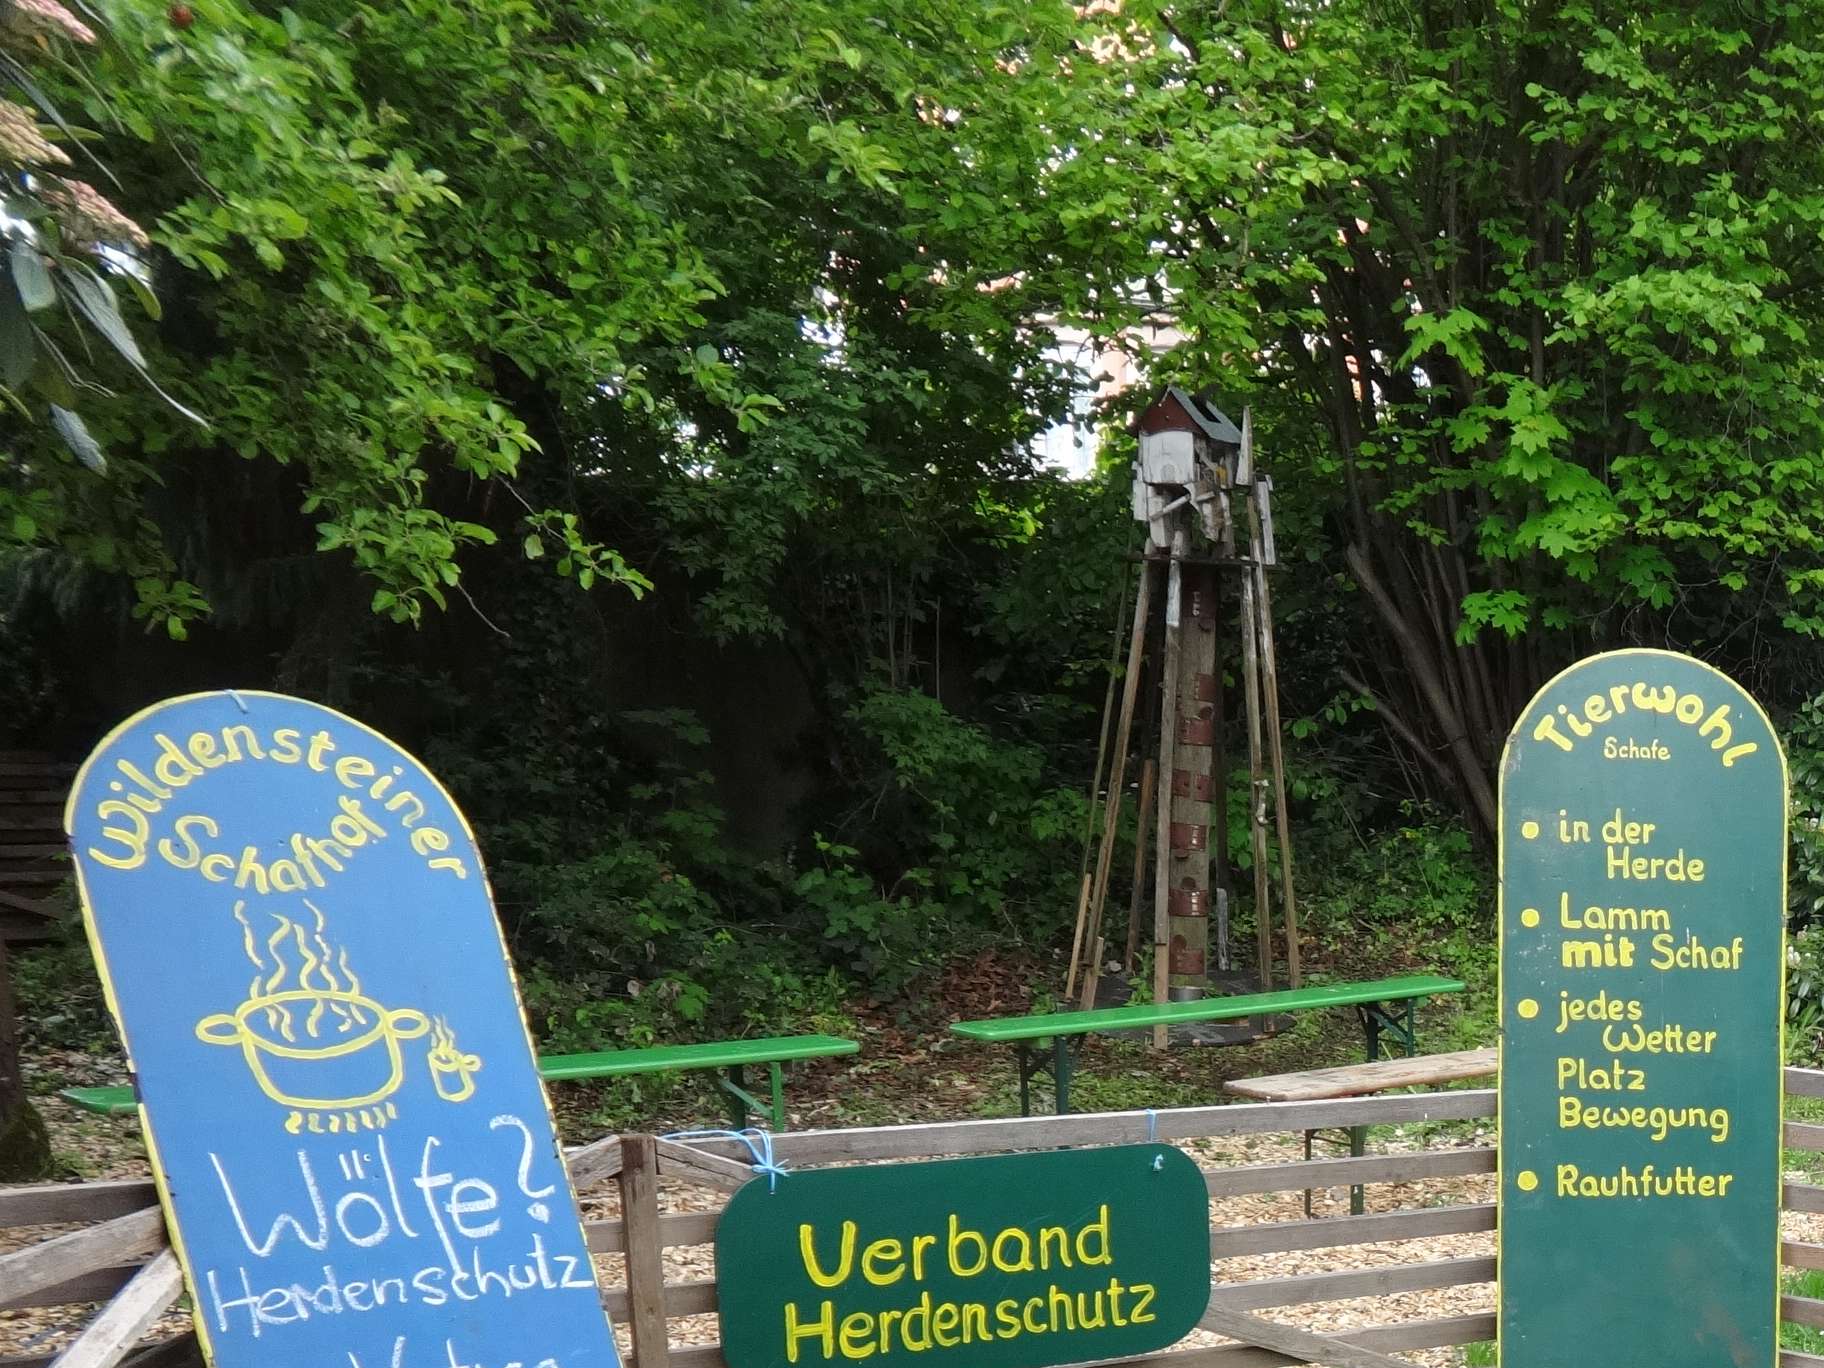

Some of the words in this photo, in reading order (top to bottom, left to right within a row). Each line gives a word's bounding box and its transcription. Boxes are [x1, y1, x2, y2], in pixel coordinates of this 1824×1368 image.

[1533, 682, 1757, 767] Tierwohl
[1603, 737, 1671, 760] Schafe
[89, 724, 467, 879] Wildensteiner
[158, 796, 387, 893] Schafhof
[1559, 809, 1591, 842] in
[1602, 808, 1656, 844] der
[1607, 846, 1705, 881] Herde
[1560, 892, 1671, 930] Lamm
[1562, 934, 1635, 968] mit
[1650, 934, 1743, 970] Schaf
[1556, 990, 1642, 1033] jedes
[1603, 1024, 1717, 1053] Wetter
[1558, 1057, 1645, 1090] Platz
[1559, 1096, 1729, 1142] Bewegung
[208, 1114, 556, 1275] Wölfe?
[1557, 1165, 1733, 1197] Rauhfutter
[799, 1204, 1112, 1288] Verband
[207, 1232, 595, 1337] Herdenschutz
[784, 1278, 1157, 1364] Herdenschutz
